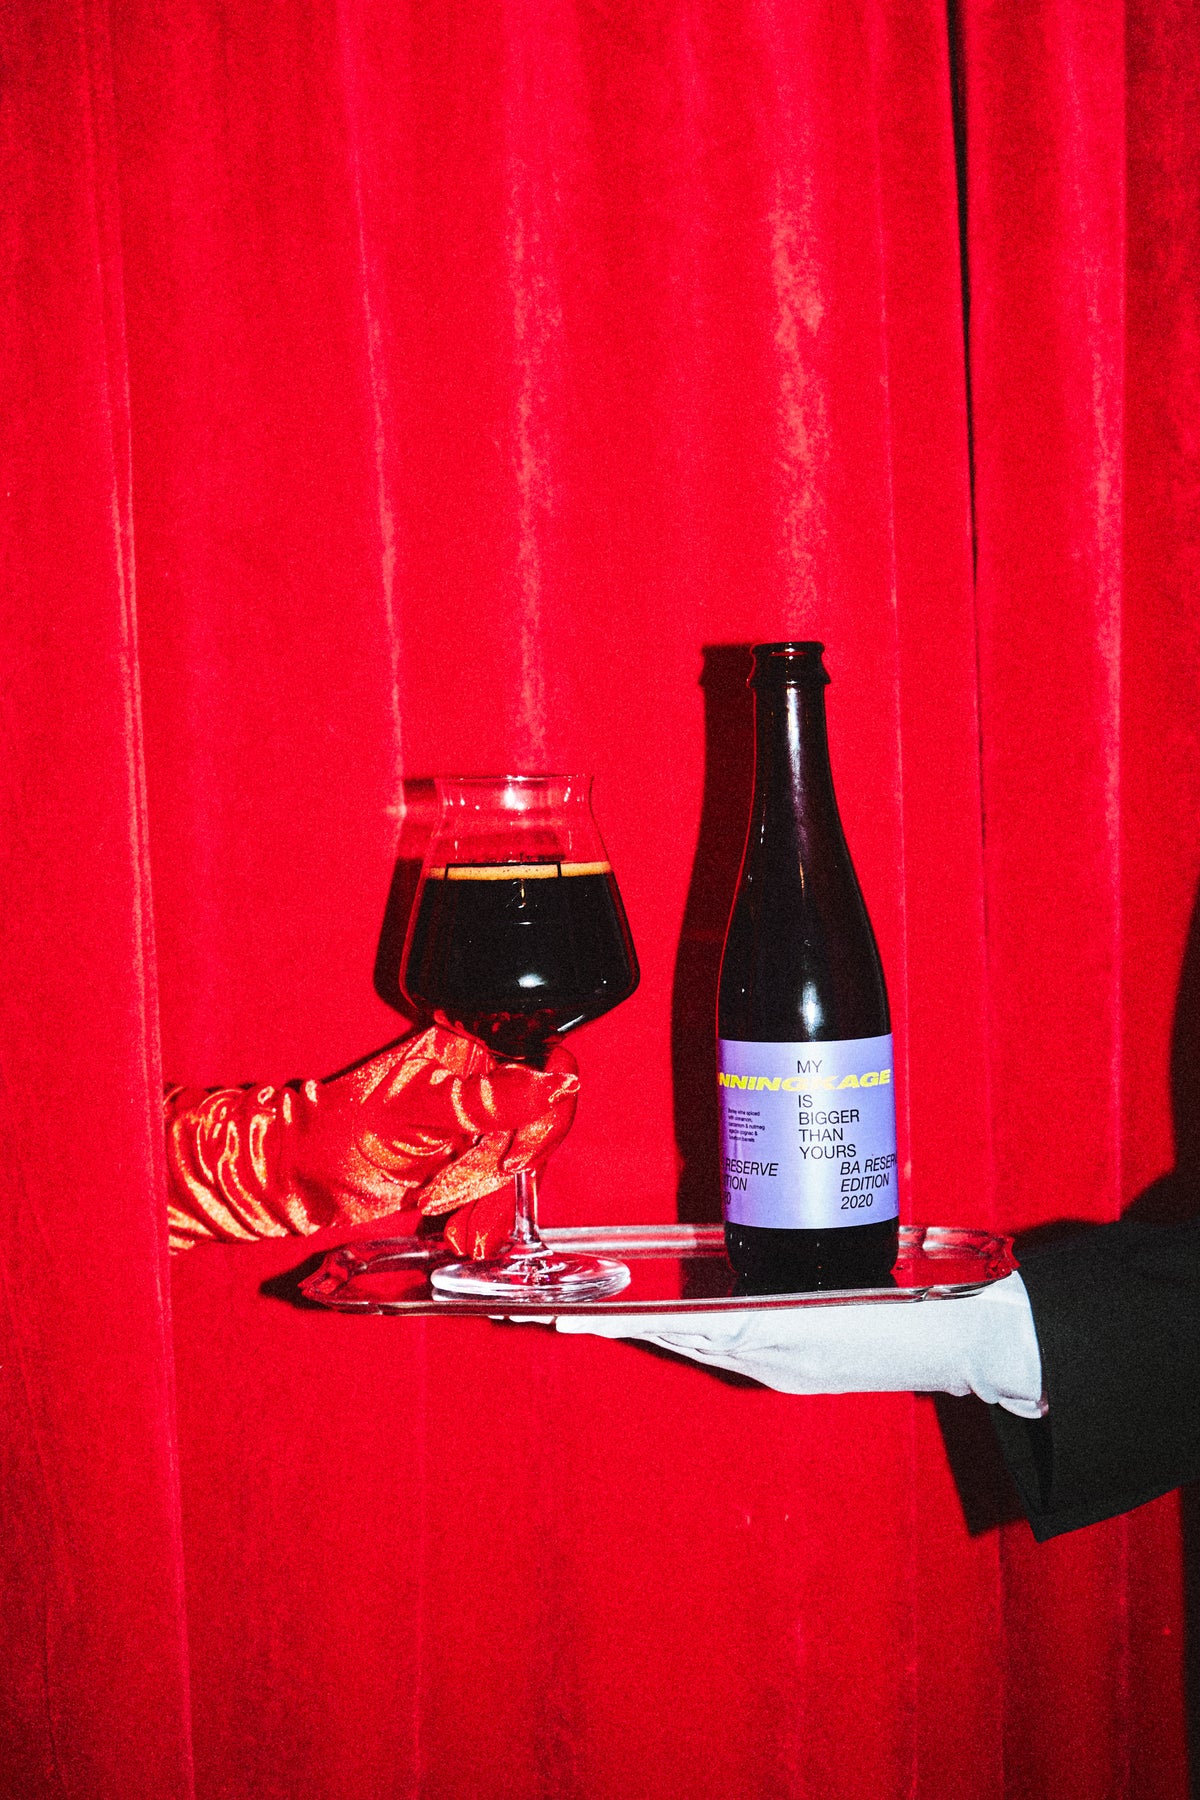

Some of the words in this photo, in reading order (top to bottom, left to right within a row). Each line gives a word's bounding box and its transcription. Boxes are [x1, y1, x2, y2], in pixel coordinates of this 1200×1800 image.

[797, 1060, 822, 1073] MY
[798, 1094, 813, 1108] IS
[799, 1109, 860, 1125] BIGGER
[798, 1128, 843, 1142] THAN
[799, 1144, 856, 1159] YOURS
[726, 1157, 779, 1177] RESERVE
[840, 1161, 860, 1175] BA
[841, 1172, 890, 1192] EDITION
[841, 1193, 873, 1210] 2020
